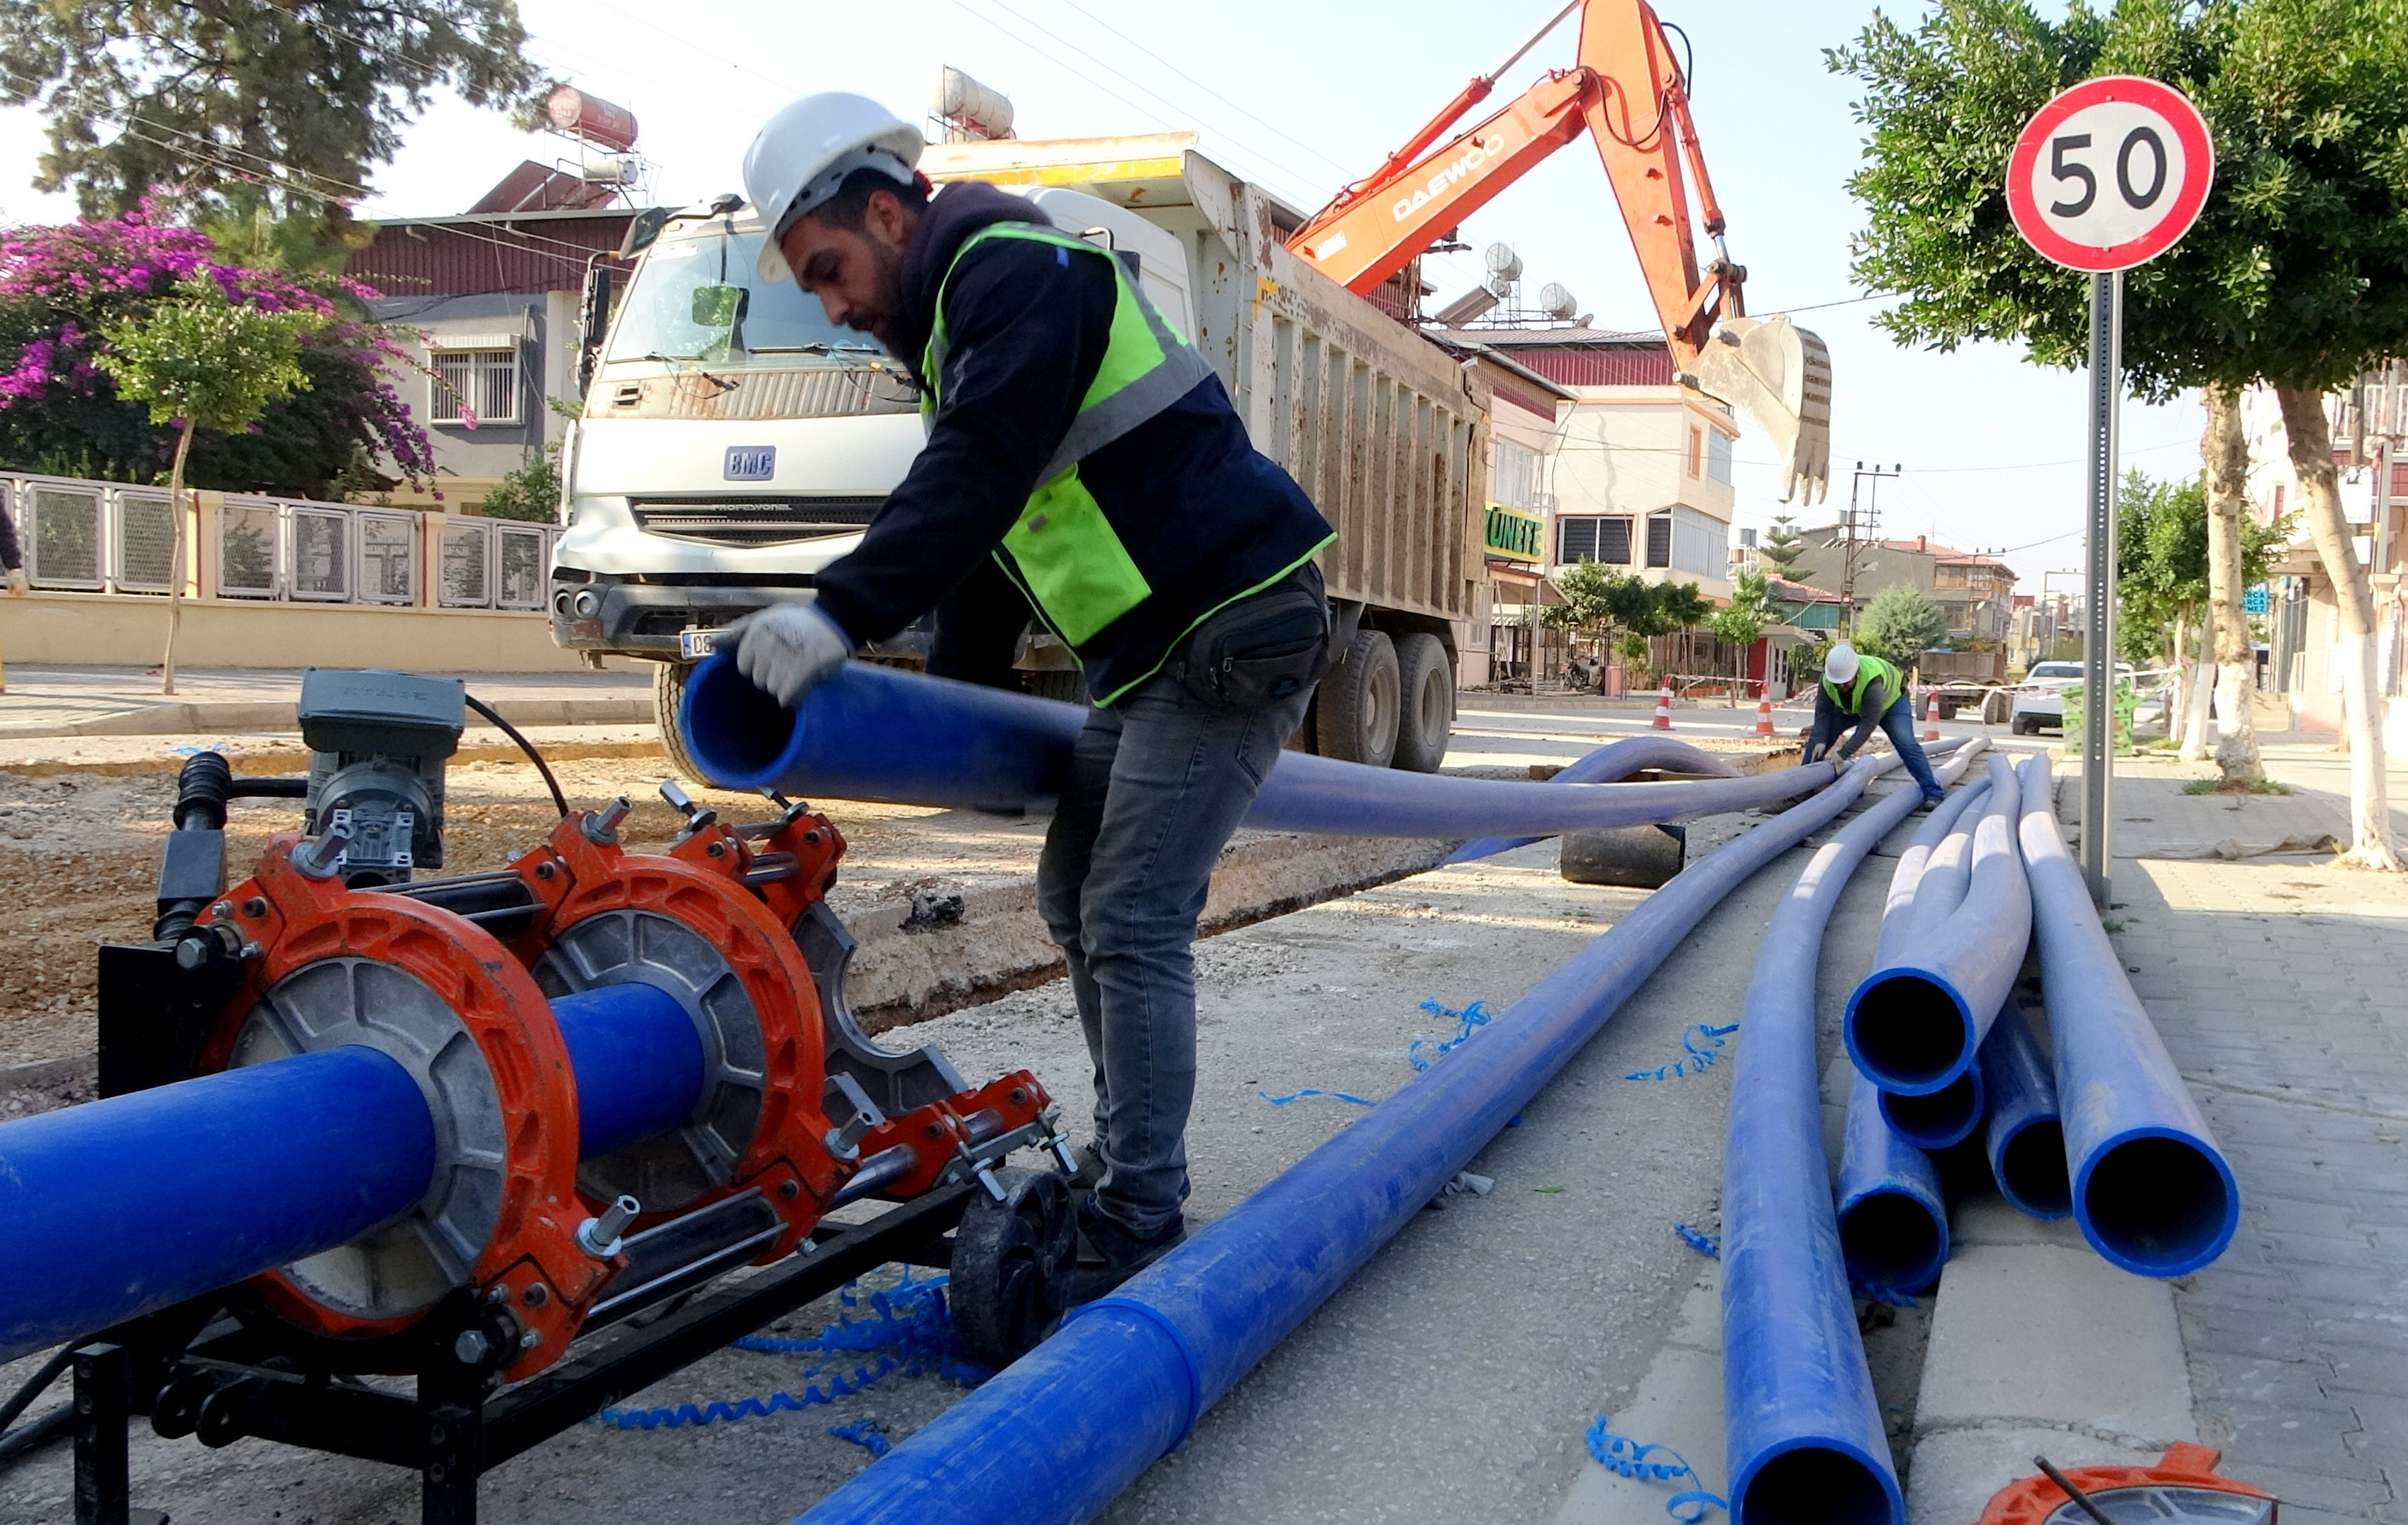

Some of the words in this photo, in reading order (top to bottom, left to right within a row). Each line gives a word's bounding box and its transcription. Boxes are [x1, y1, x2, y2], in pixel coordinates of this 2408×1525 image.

[1392, 133, 1504, 221] DAEWOO
[2050, 126, 2167, 218] 50
[730, 453, 772, 475] BMC
